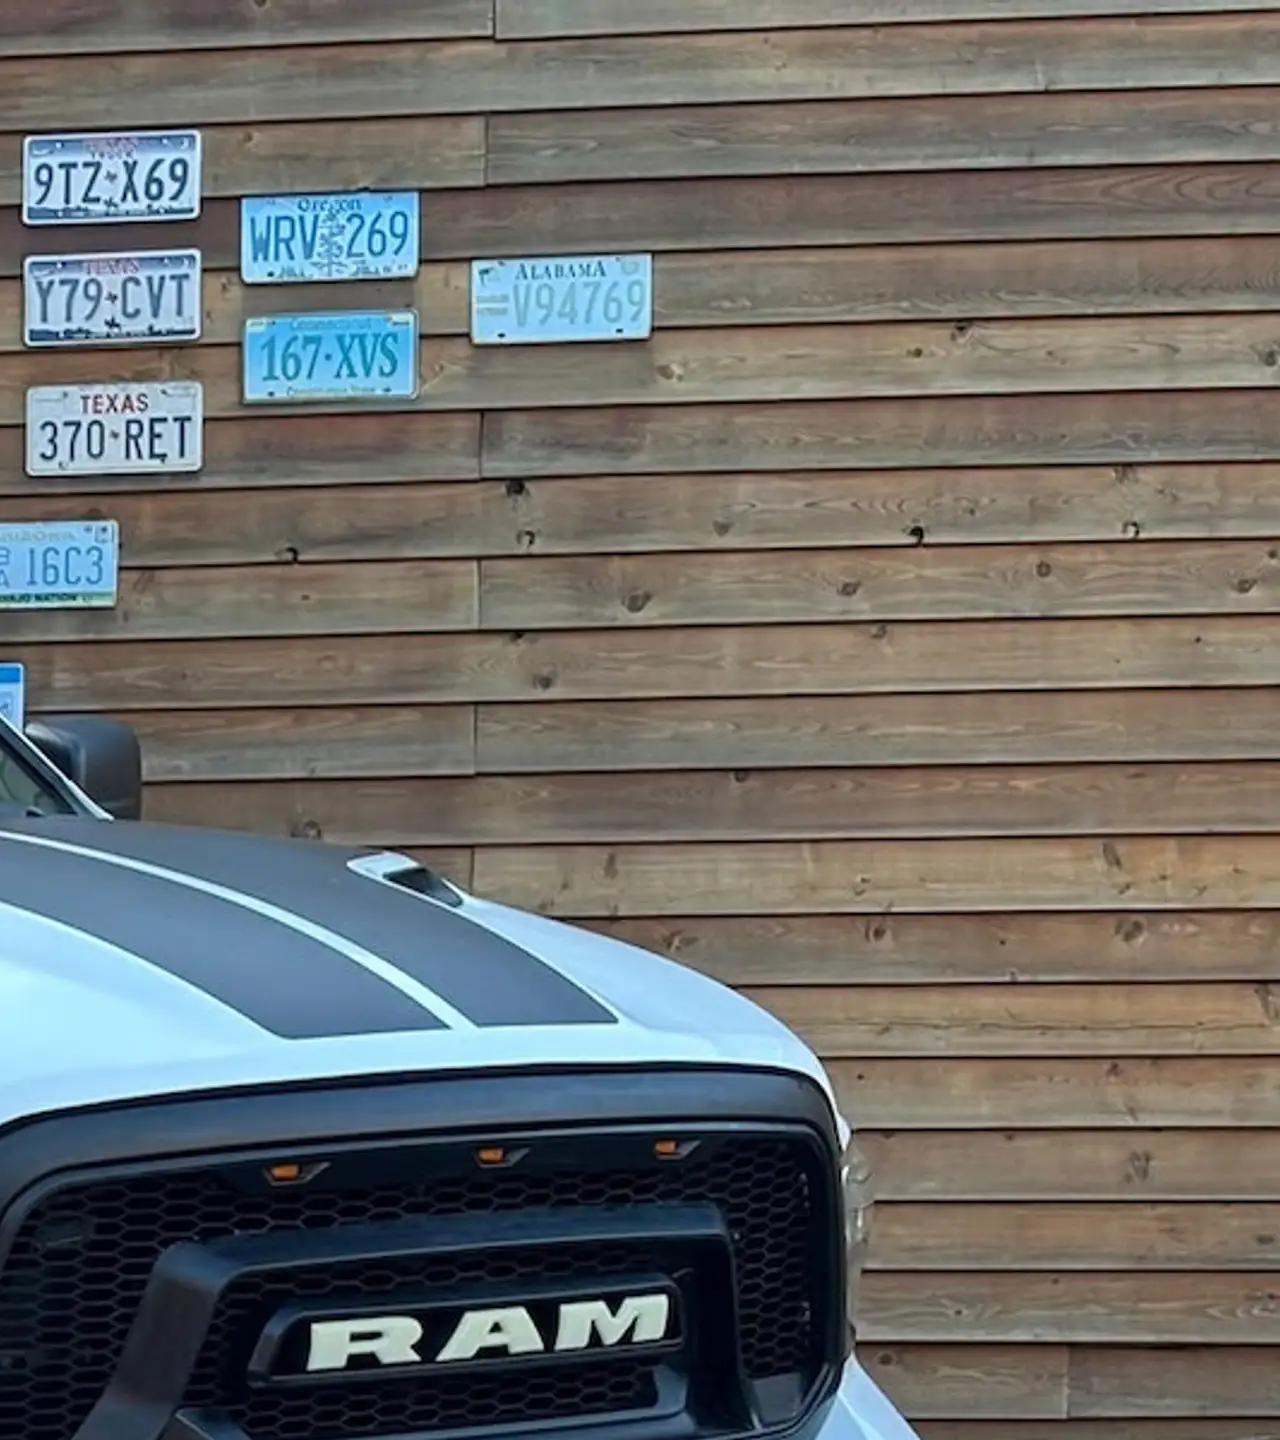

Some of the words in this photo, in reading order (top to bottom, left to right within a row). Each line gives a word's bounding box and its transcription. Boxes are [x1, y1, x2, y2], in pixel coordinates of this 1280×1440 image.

[515, 260, 606, 280] ALABAMA
[80, 394, 149, 414] TEXAS
[39, 419, 105, 461] 370
[125, 416, 192, 460] RET
[306, 1294, 669, 1373] RAM
